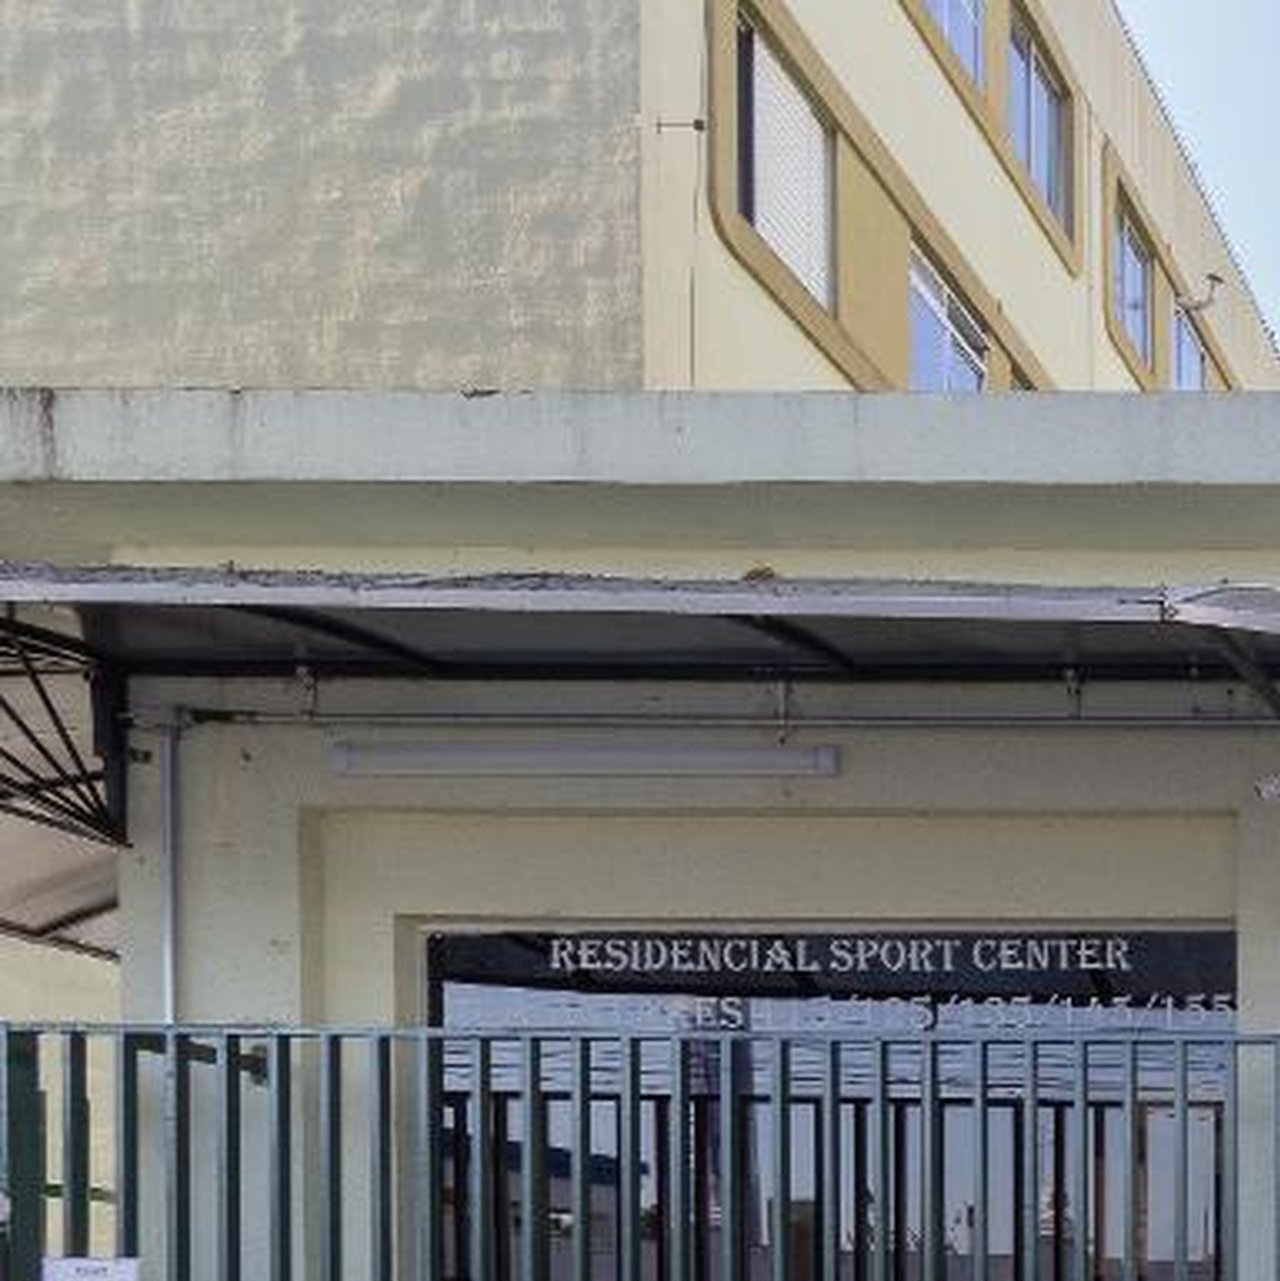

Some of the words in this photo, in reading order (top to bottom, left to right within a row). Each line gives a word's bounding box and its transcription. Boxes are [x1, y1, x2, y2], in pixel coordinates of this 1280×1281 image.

[550, 938, 820, 972] RESIDENCIAL
[830, 937, 961, 972] SPORT
[973, 937, 1131, 972] CENTER
